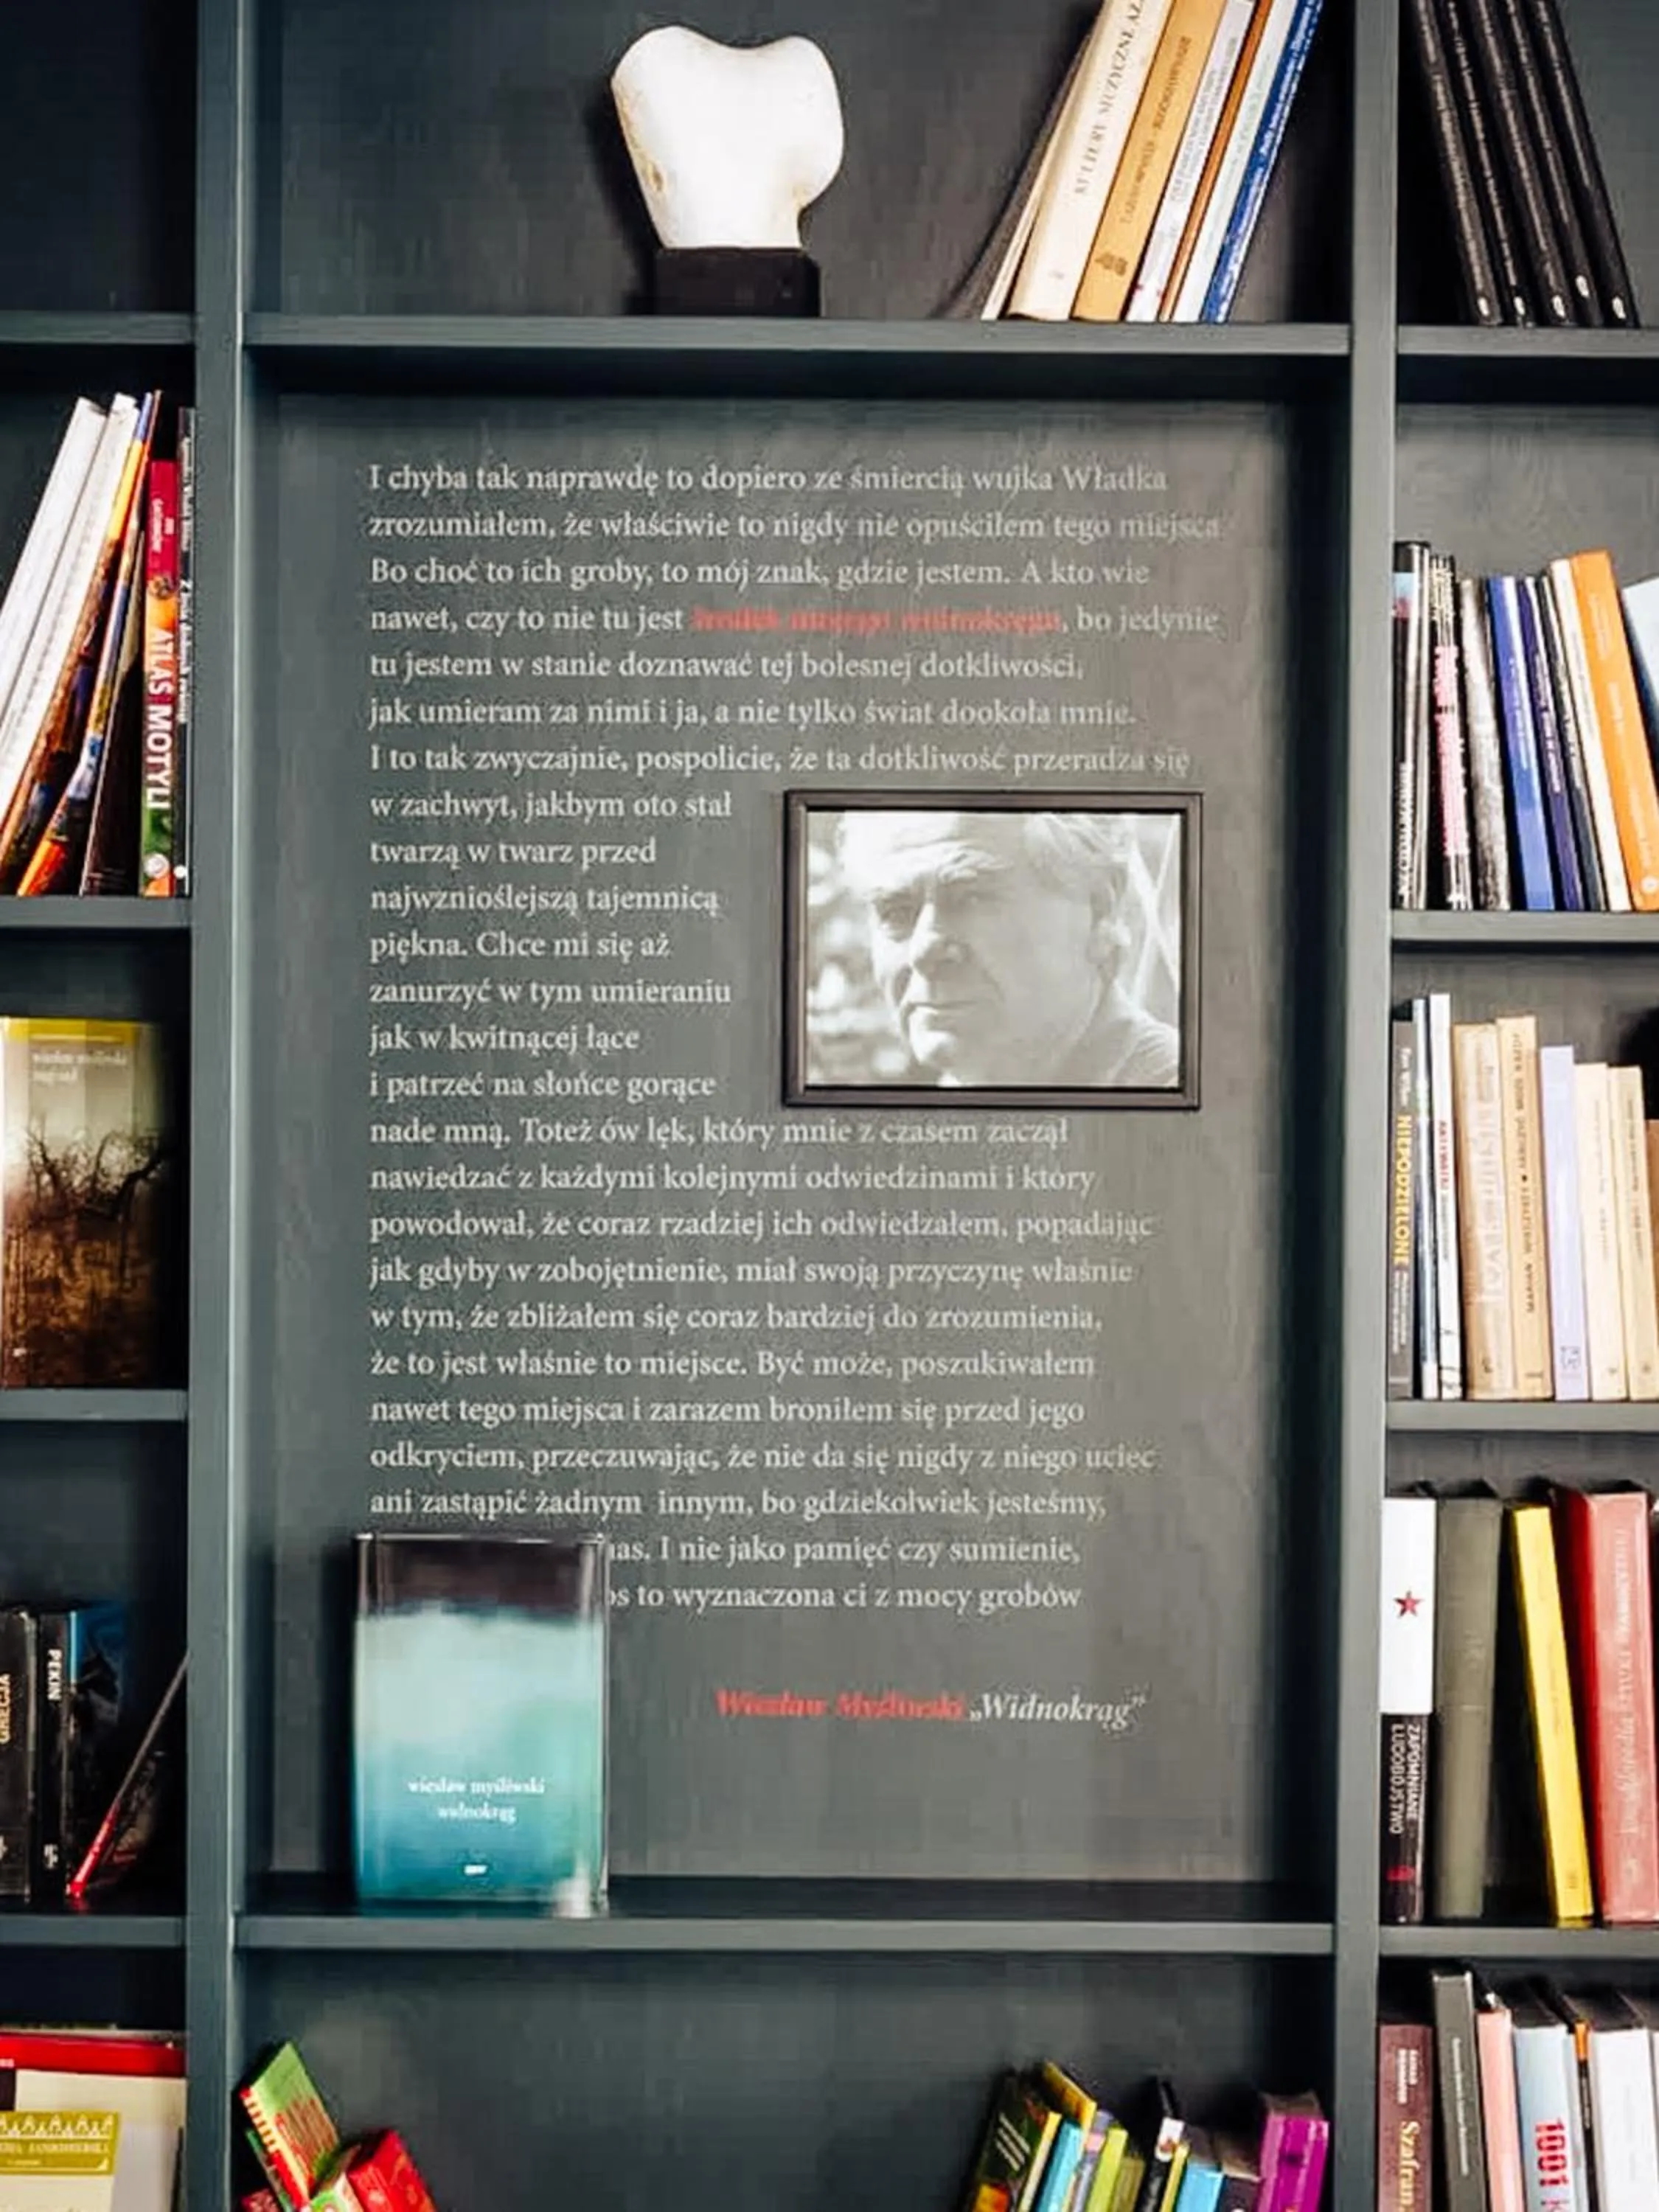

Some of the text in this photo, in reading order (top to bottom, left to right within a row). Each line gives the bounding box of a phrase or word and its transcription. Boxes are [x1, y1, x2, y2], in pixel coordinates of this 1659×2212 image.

[387, 463, 468, 497] chyba
[476, 463, 520, 490] tak
[526, 463, 659, 497] naprawdę
[666, 467, 694, 490] to
[700, 463, 807, 497] dopiero
[850, 463, 964, 497] śmiercią
[972, 463, 1053, 497] wujka
[369, 509, 557, 540] zrozumiałem,
[600, 509, 730, 536] właściwie
[773, 509, 849, 543] nigdy
[858, 509, 899, 536] nie
[1054, 513, 1110, 543] tego
[414, 556, 1094, 590] choć ich groby, mój znak, gdzie jestem. kto
[370, 606, 459, 633] nawet,
[465, 610, 510, 636] czy
[552, 602, 596, 629] nie
[636, 602, 684, 636] jest
[403, 650, 493, 684] jestem
[531, 650, 612, 676] stanie
[618, 650, 753, 676] doznawać
[760, 650, 793, 684] tej
[801, 650, 912, 684] bolesnej
[146, 627, 174, 809] ATLAS MOTYLI
[367, 696, 412, 730] jak
[418, 696, 542, 723] umieram
[587, 696, 651, 723] nimi
[673, 696, 708, 730] ja,
[737, 696, 780, 723] nie
[787, 696, 857, 730] tylko
[864, 696, 933, 723] świat
[424, 742, 1006, 776] tak zwyczajnie, pospolicie, dotkliwość
[400, 789, 732, 823] zachwyt, jakbym oto stał
[369, 835, 657, 869] twarzą twarz przed
[370, 882, 720, 916] najwznioślejszą tajemnicą
[369, 928, 633, 962] piękna. Chce się
[369, 975, 731, 1009] zanurzyć tym umieraniu
[368, 1022, 640, 1056] jak kwitnącej łące
[386, 1068, 717, 1102] patrzeć słońce gorące
[369, 1115, 1068, 1149] nade mną. Toteż lęk, który mnie czasem zaczął
[370, 1161, 998, 1195] nawiedzać każdymi kolejnymi odwiedzinami
[1393, 1115, 1412, 1266] NIEPODZIELONE
[369, 1208, 535, 1242] powodował,
[577, 1215, 651, 1234] coraz
[658, 1208, 764, 1242] rzadziej
[773, 1208, 813, 1234] ich
[369, 1254, 1024, 1288] jak gdyby zobojętnienie, miał swoją przyczynę
[401, 1305, 463, 1335] tym,
[506, 1301, 635, 1328] zbliżałem
[642, 1301, 680, 1335] się
[686, 1309, 759, 1328] coraz
[766, 1301, 875, 1335] bardziej
[440, 1348, 1095, 1382] jest właśnie miejsce. Być może, poszukiwałem
[370, 1394, 1085, 1428] nawet tego miejsca zarazem broniłem się przed jego
[369, 1441, 1077, 1475] odkryciem, przeczuwając, nie się nigdy niego
[369, 1487, 413, 1514] ani
[420, 1487, 528, 1521] zastąpić
[535, 1487, 642, 1521] żadnym
[658, 1487, 754, 1521] innym,
[802, 1487, 980, 1521] gdziekolwiek
[679, 1534, 1080, 1568] nie jako pamięć czy sumienie,
[672, 1580, 1082, 1614] wyznaczona mocy grobów
[1406, 1723, 1421, 1820] ZAPOMNIANE
[1535, 2119, 1569, 2187] 1001
